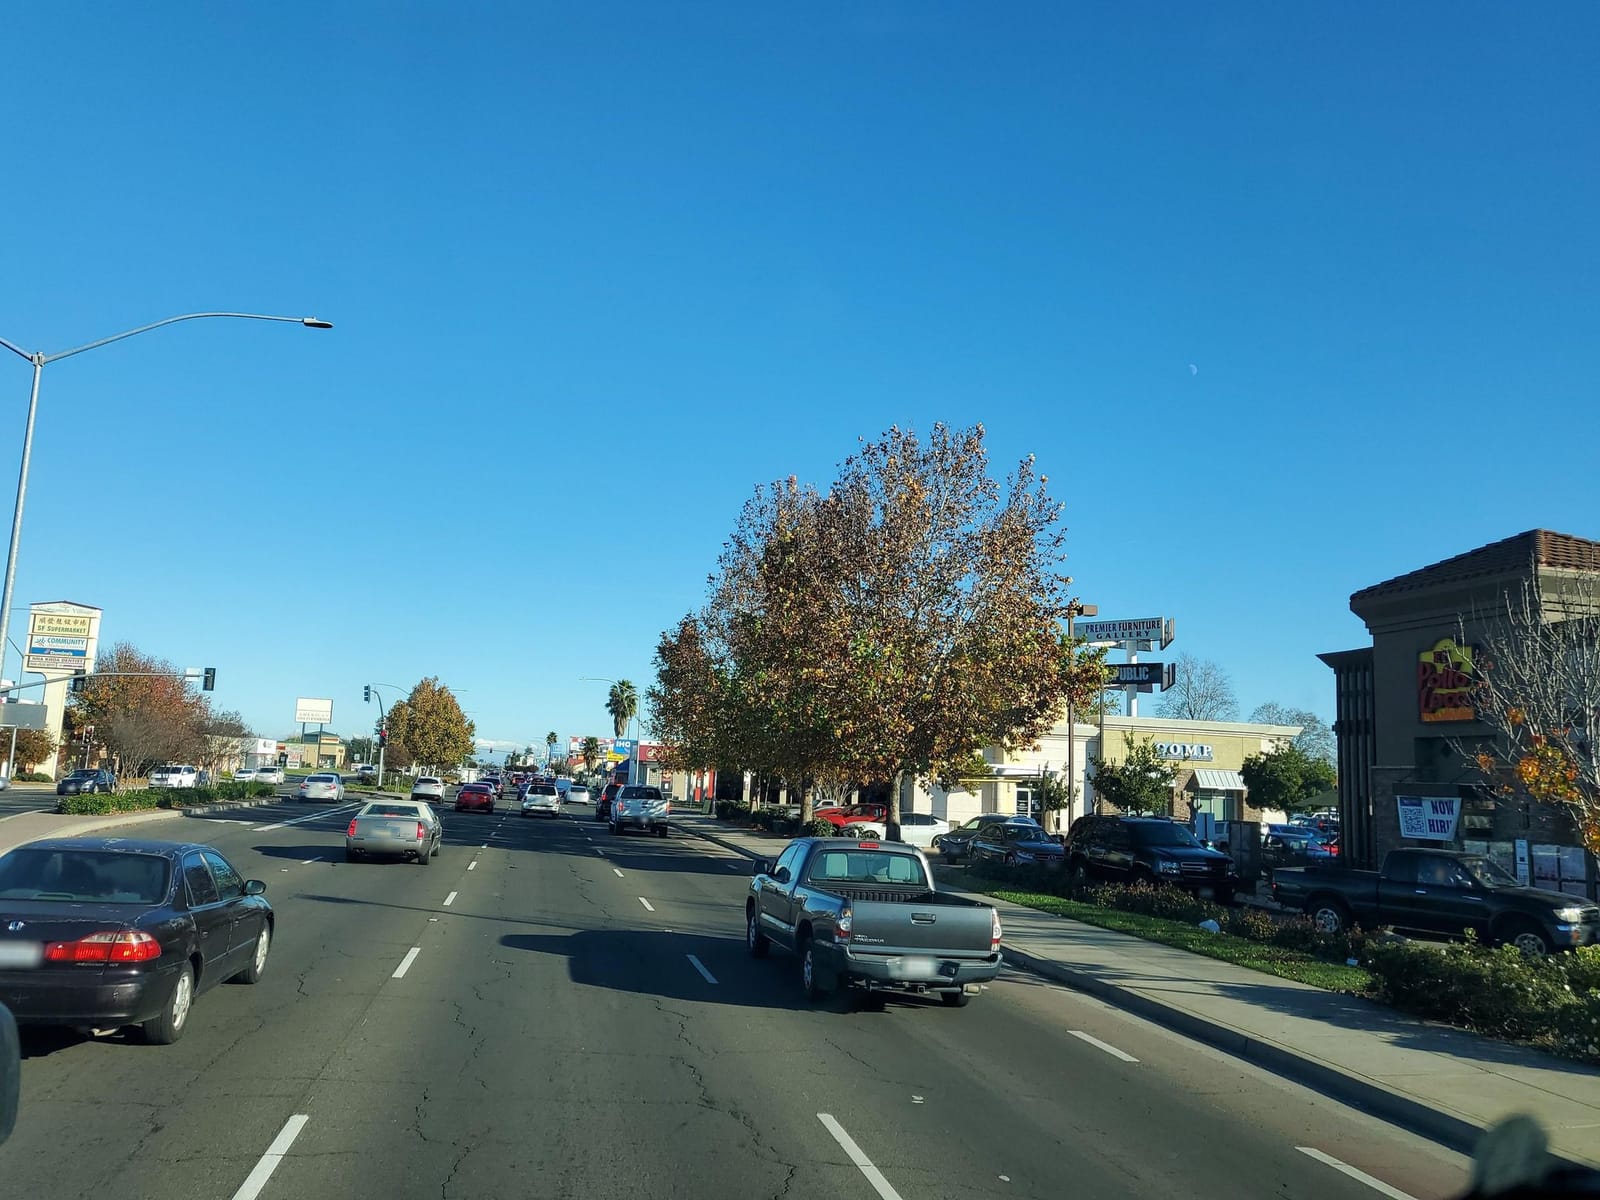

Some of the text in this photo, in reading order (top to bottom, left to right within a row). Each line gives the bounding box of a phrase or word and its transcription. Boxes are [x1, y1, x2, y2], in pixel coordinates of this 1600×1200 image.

[1085, 620, 1161, 634] PREMIER FURNITURE
[1096, 630, 1151, 640] GALLERY
[47, 637, 85, 645] COMMUNITY
[616, 740, 631, 748] IHO
[1430, 800, 1454, 815] NOW
